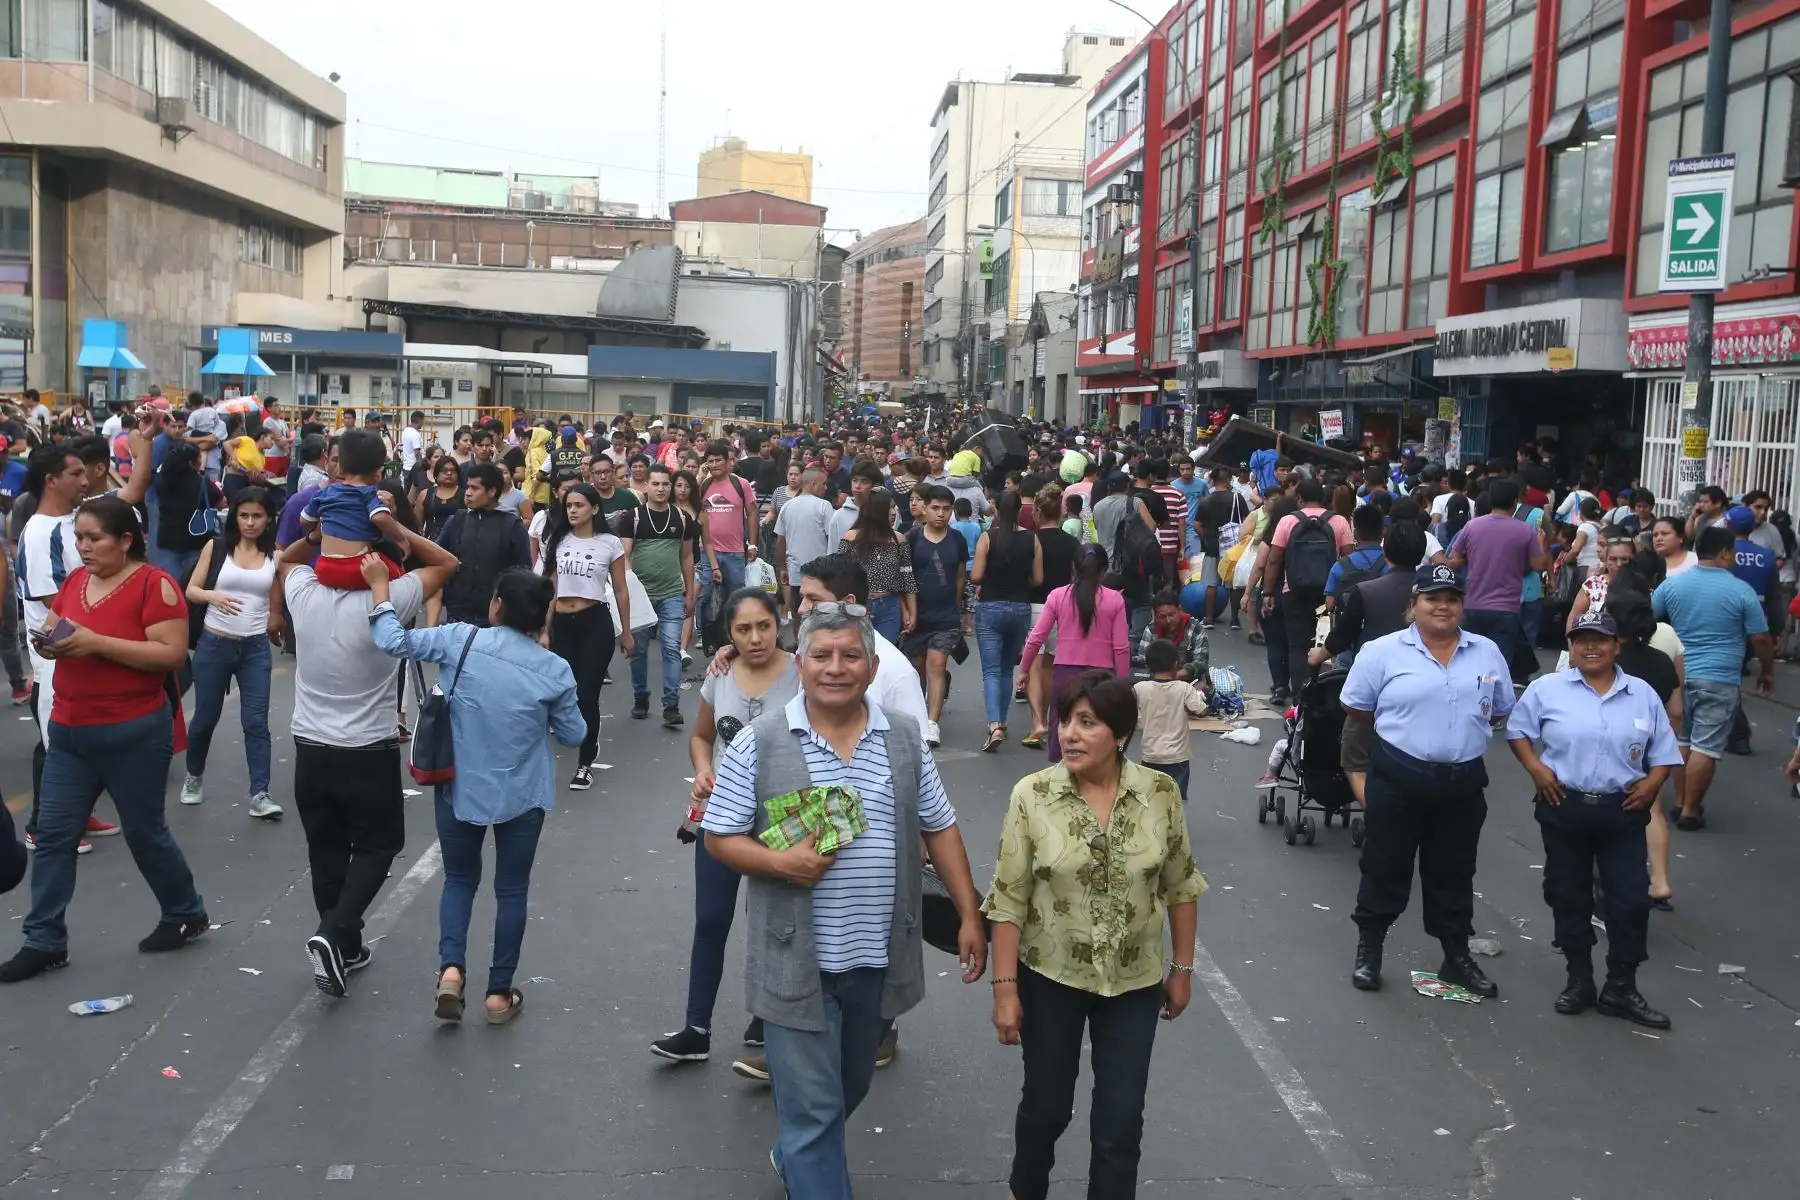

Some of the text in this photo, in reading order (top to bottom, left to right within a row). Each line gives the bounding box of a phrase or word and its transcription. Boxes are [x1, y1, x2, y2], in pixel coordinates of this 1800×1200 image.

[1679, 159, 1713, 172] Municipalidad
[1721, 156, 1735, 167] Lima
[1670, 259, 1716, 273] SALIDA
[1735, 552, 1765, 568] GFC
[558, 560, 596, 578] SMILE
